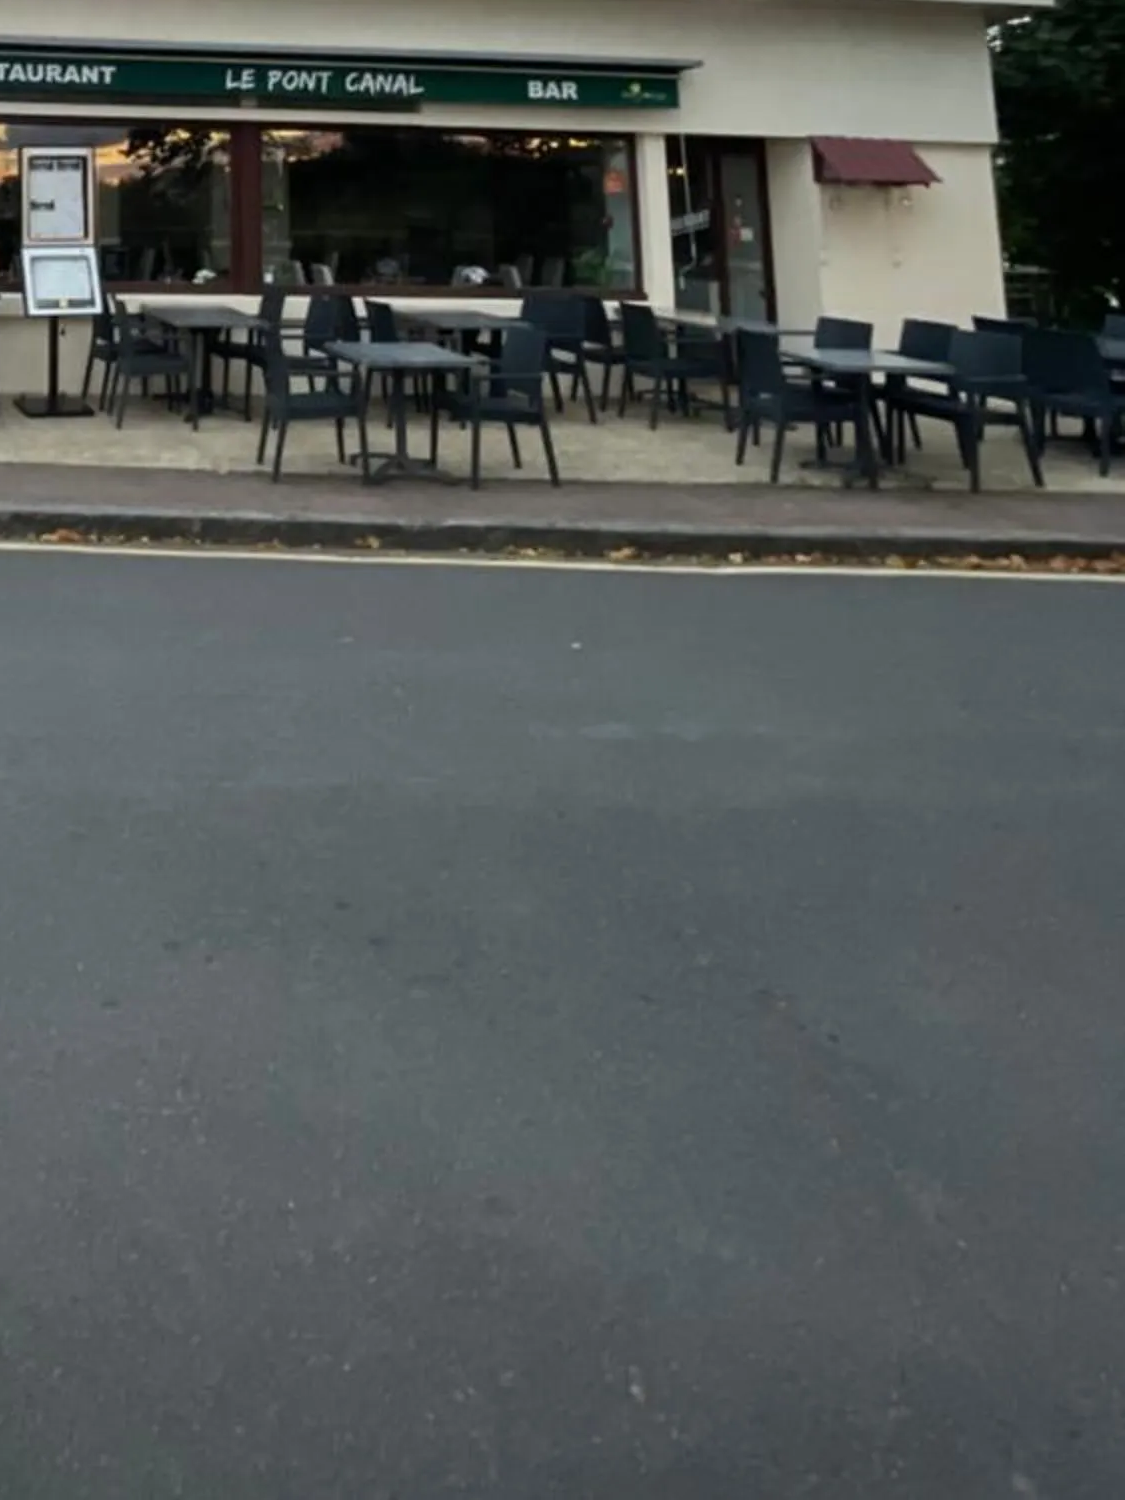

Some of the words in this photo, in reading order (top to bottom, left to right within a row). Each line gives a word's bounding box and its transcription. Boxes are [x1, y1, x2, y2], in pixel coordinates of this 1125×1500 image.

[226, 68, 255, 90] LE
[267, 69, 331, 94] PONT
[345, 72, 425, 96] CANAL
[527, 80, 579, 101] BAR
